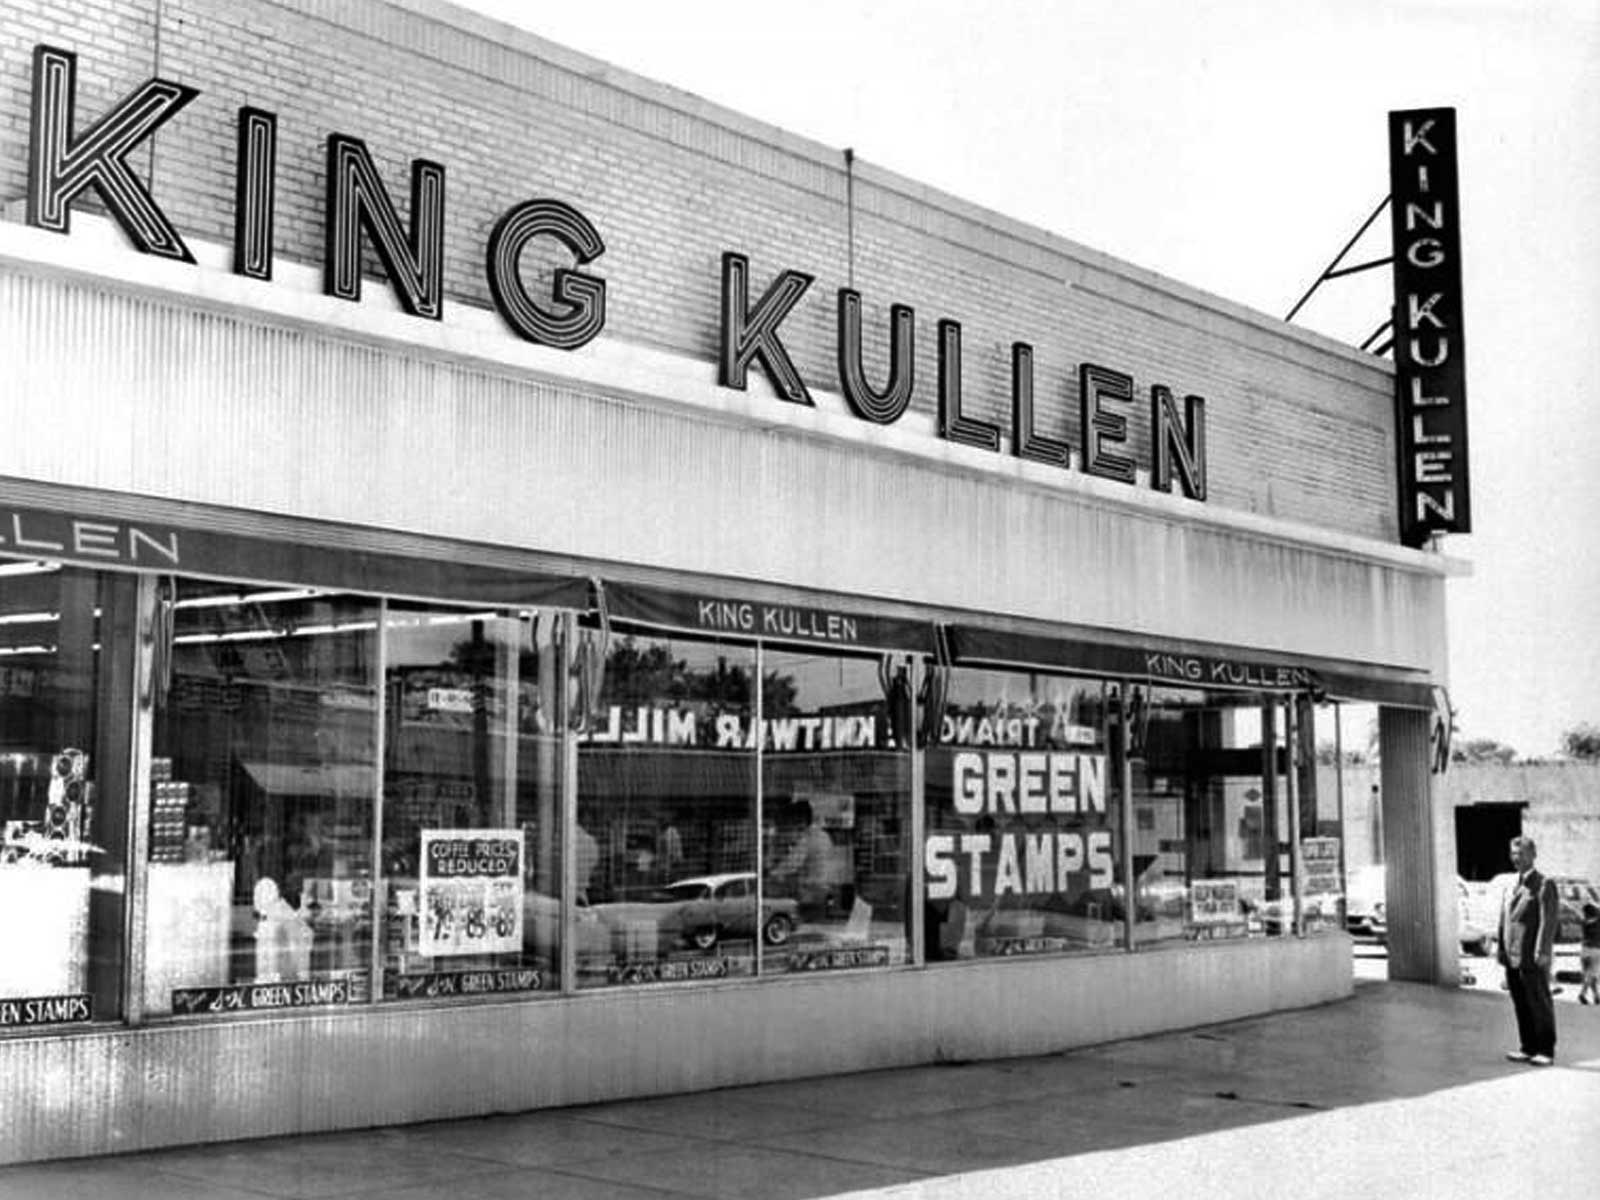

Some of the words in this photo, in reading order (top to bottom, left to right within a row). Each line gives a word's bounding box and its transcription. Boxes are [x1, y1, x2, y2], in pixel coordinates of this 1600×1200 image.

[1403, 119, 1445, 268] KING
[26, 43, 606, 351] KING
[718, 251, 1207, 501] KULLEN
[1408, 292, 1455, 522] KULLEN
[0, 512, 179, 565] LEN
[698, 600, 754, 629] KING
[763, 606, 858, 641] KULLEN
[1144, 652, 1201, 679] KING
[1211, 661, 1311, 687] KULLEN
[953, 752, 1106, 814] GREEN
[925, 832, 1114, 899] STAMPS
[25, 997, 89, 1022] STAMPS
[251, 986, 290, 1008] GREEN
[294, 982, 347, 1005] STAMPS
